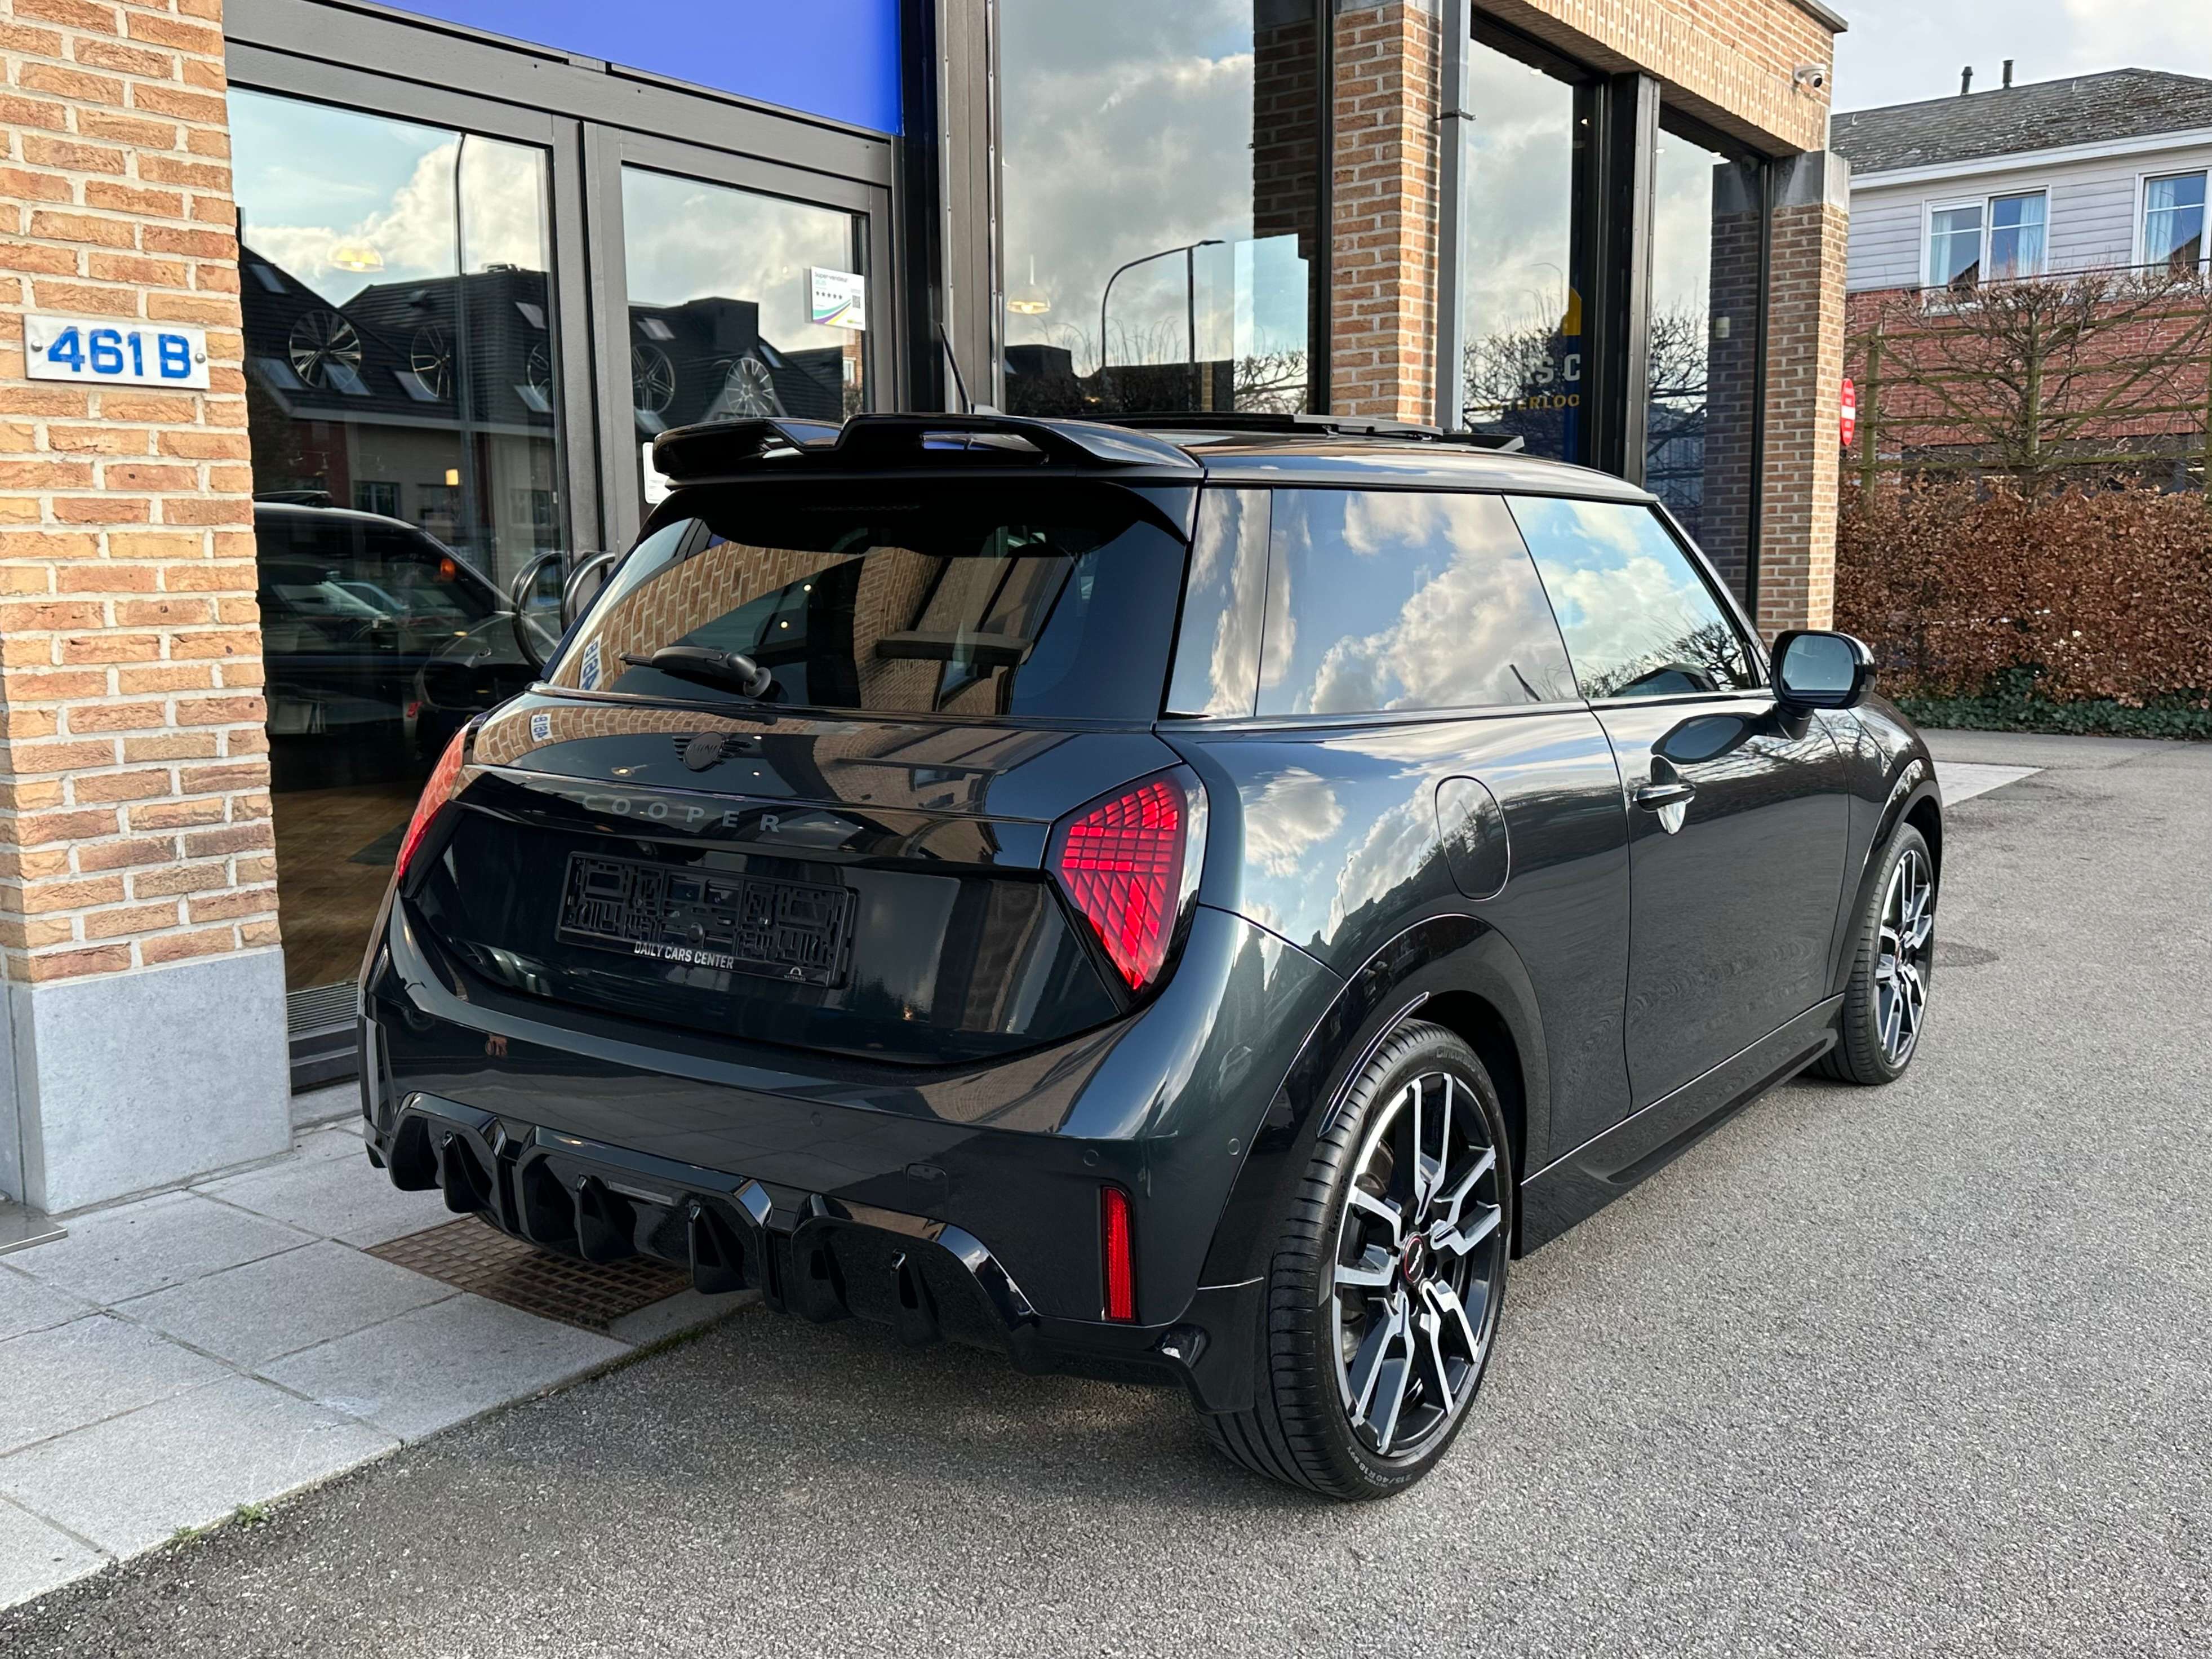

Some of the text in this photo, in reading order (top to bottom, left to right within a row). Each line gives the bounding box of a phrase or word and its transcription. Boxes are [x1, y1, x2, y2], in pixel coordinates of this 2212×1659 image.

[48, 326, 191, 379] 461 B
[581, 795, 780, 832] COOPER
[634, 941, 734, 969] DAILY CARS CENTER
